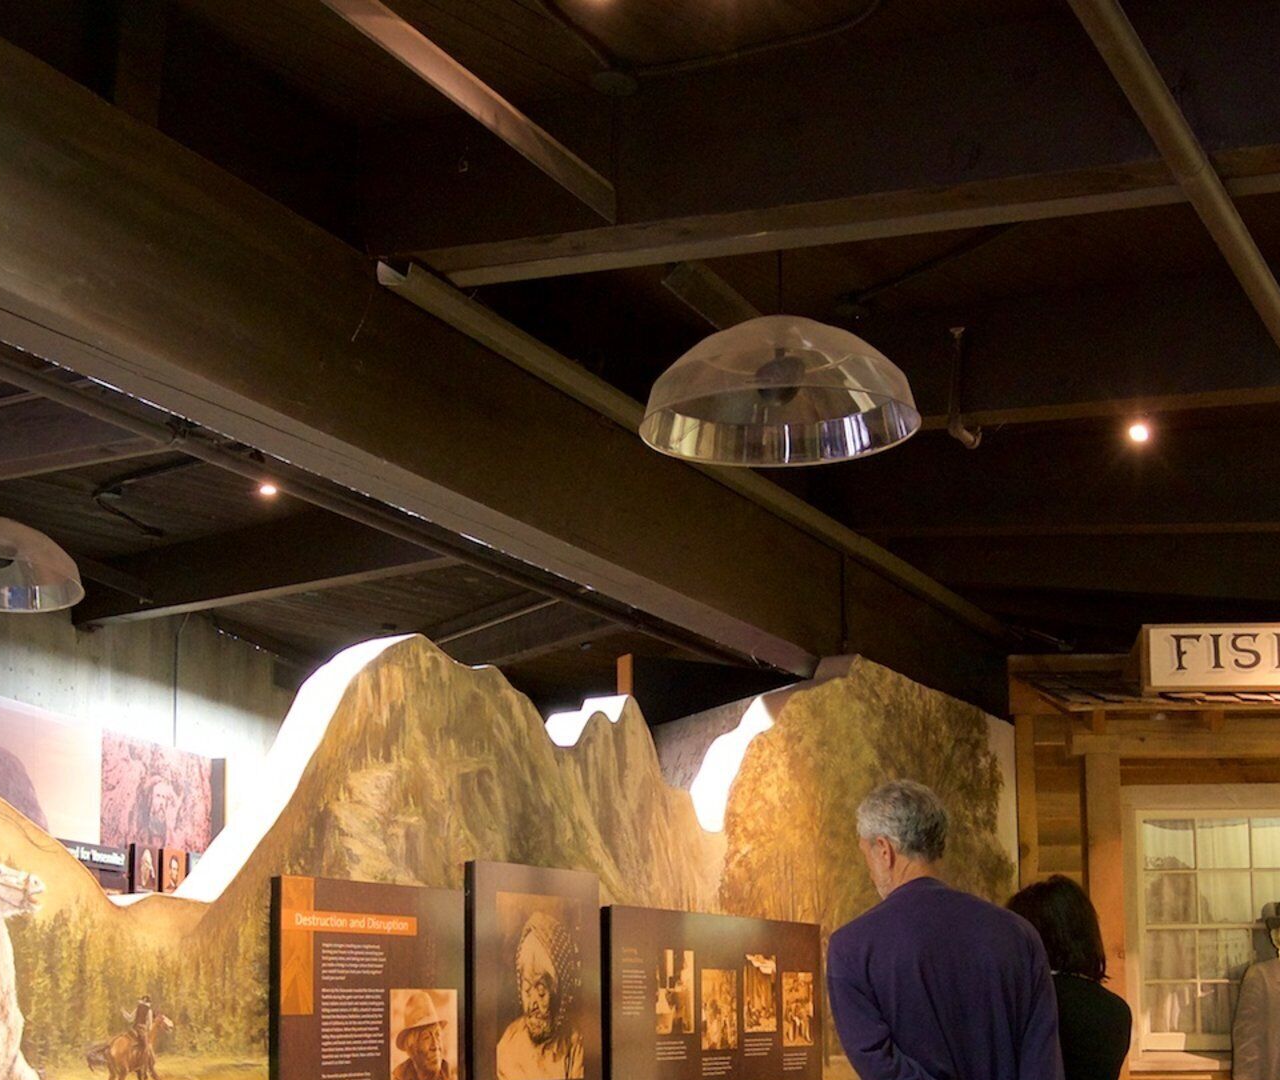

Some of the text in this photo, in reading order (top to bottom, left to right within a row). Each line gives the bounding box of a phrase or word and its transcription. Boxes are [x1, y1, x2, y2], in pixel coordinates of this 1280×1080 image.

[295, 912, 409, 934] Destruction and Disruption
